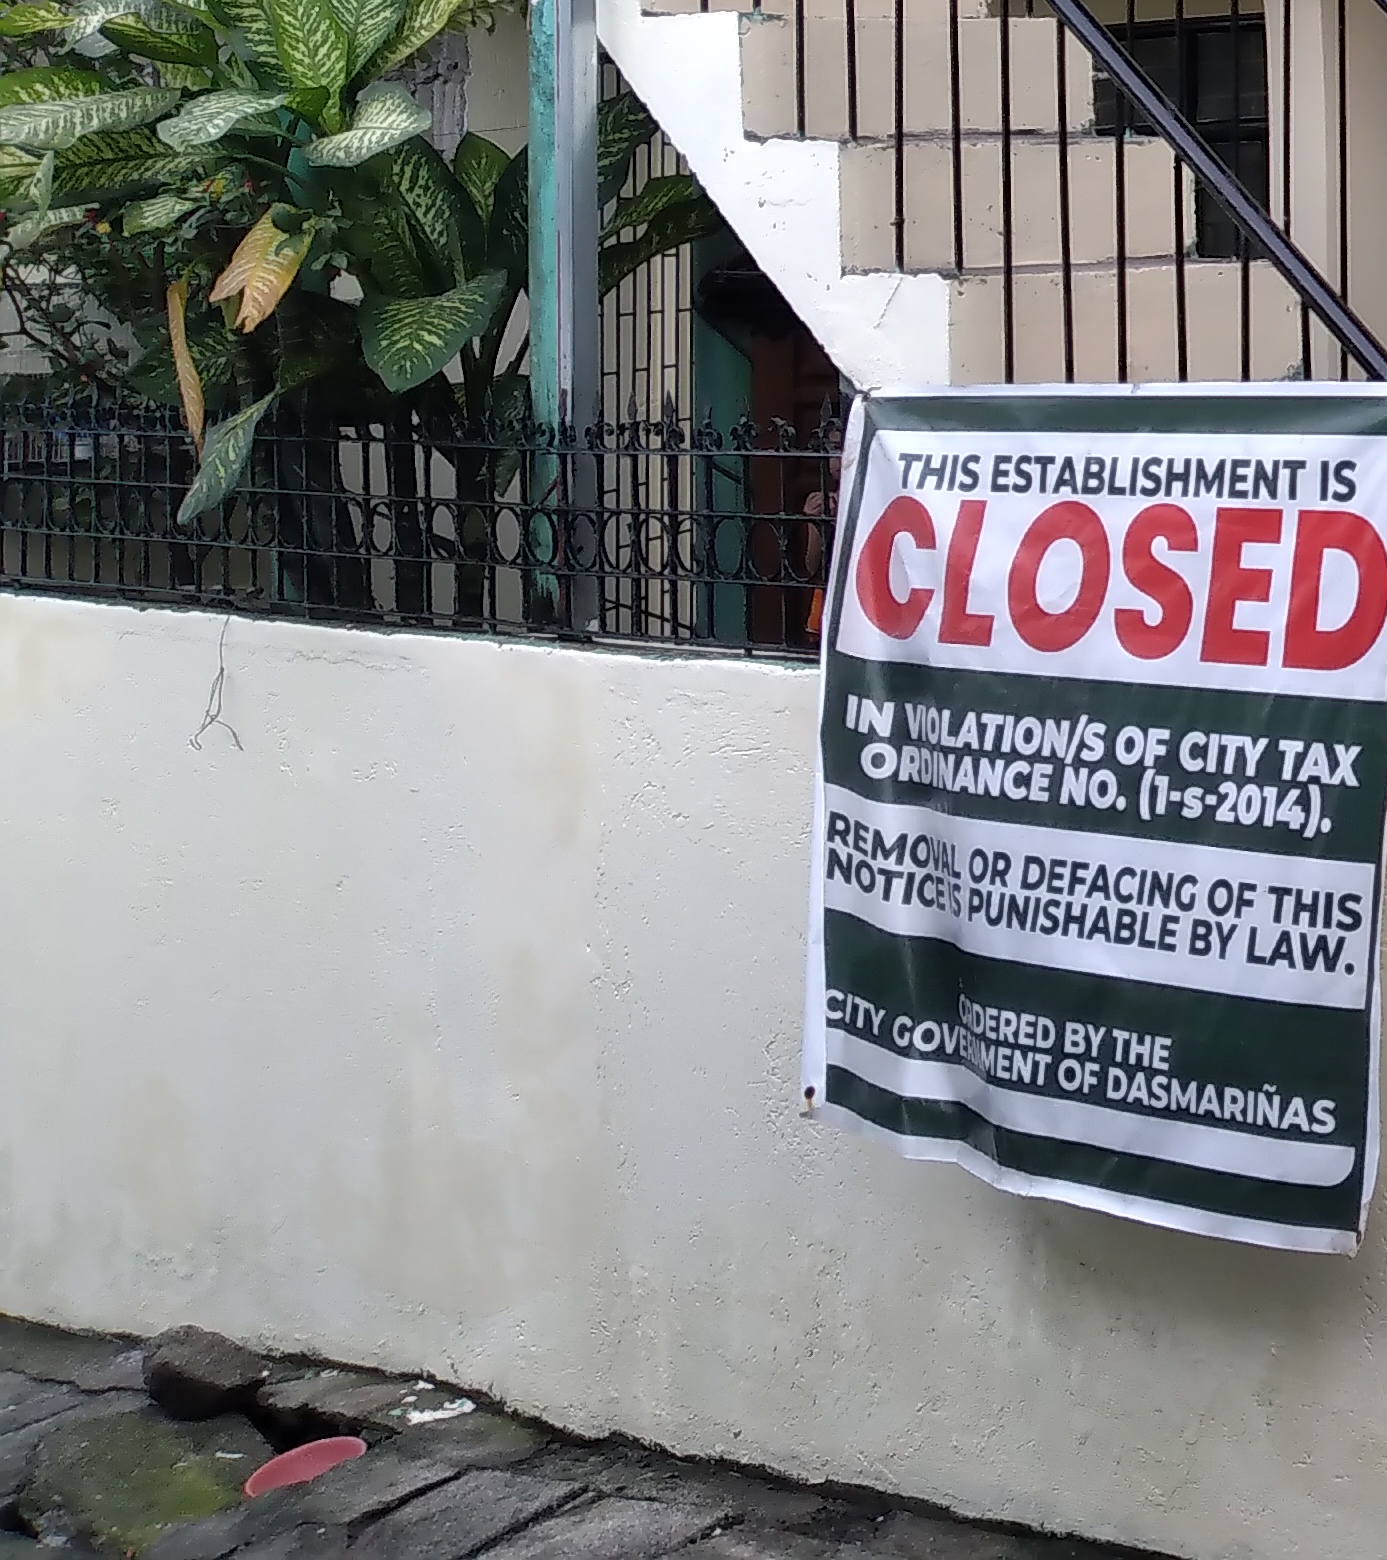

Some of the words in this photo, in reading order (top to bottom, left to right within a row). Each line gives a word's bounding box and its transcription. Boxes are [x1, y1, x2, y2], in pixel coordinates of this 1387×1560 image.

[898, 452, 982, 492] THIS
[990, 454, 1307, 501] ESTABLISHMENT
[1319, 459, 1358, 503] IS
[845, 693, 896, 738] IN
[904, 701, 1107, 765] VIOLATION/S
[1115, 725, 1171, 767] OF
[1178, 731, 1270, 778] CITY
[1278, 739, 1363, 788] TAX
[860, 742, 1054, 803] ORDINANCE
[1058, 765, 1127, 812] NO.
[825, 846, 946, 912] NOTICE
[948, 880, 962, 919] IS
[967, 886, 1181, 953] PUNISHABLE
[1188, 918, 1239, 961] BY
[1245, 925, 1355, 976] LAW.
[826, 810, 962, 880] REMOVAL
[968, 847, 1012, 889] OR
[1020, 854, 1199, 913] DEFACING
[1207, 878, 1258, 919] OF
[1268, 885, 1363, 933] THIS
[826, 989, 888, 1037] CITY
[892, 1015, 1053, 1087] GOVERNMENT
[1057, 1058, 1101, 1095] OF
[1106, 1066, 1337, 1135] DASMARIÑAS
[958, 992, 1057, 1049] ORDERED
[1063, 1021, 1107, 1059] BY
[1112, 1028, 1173, 1071] THE
